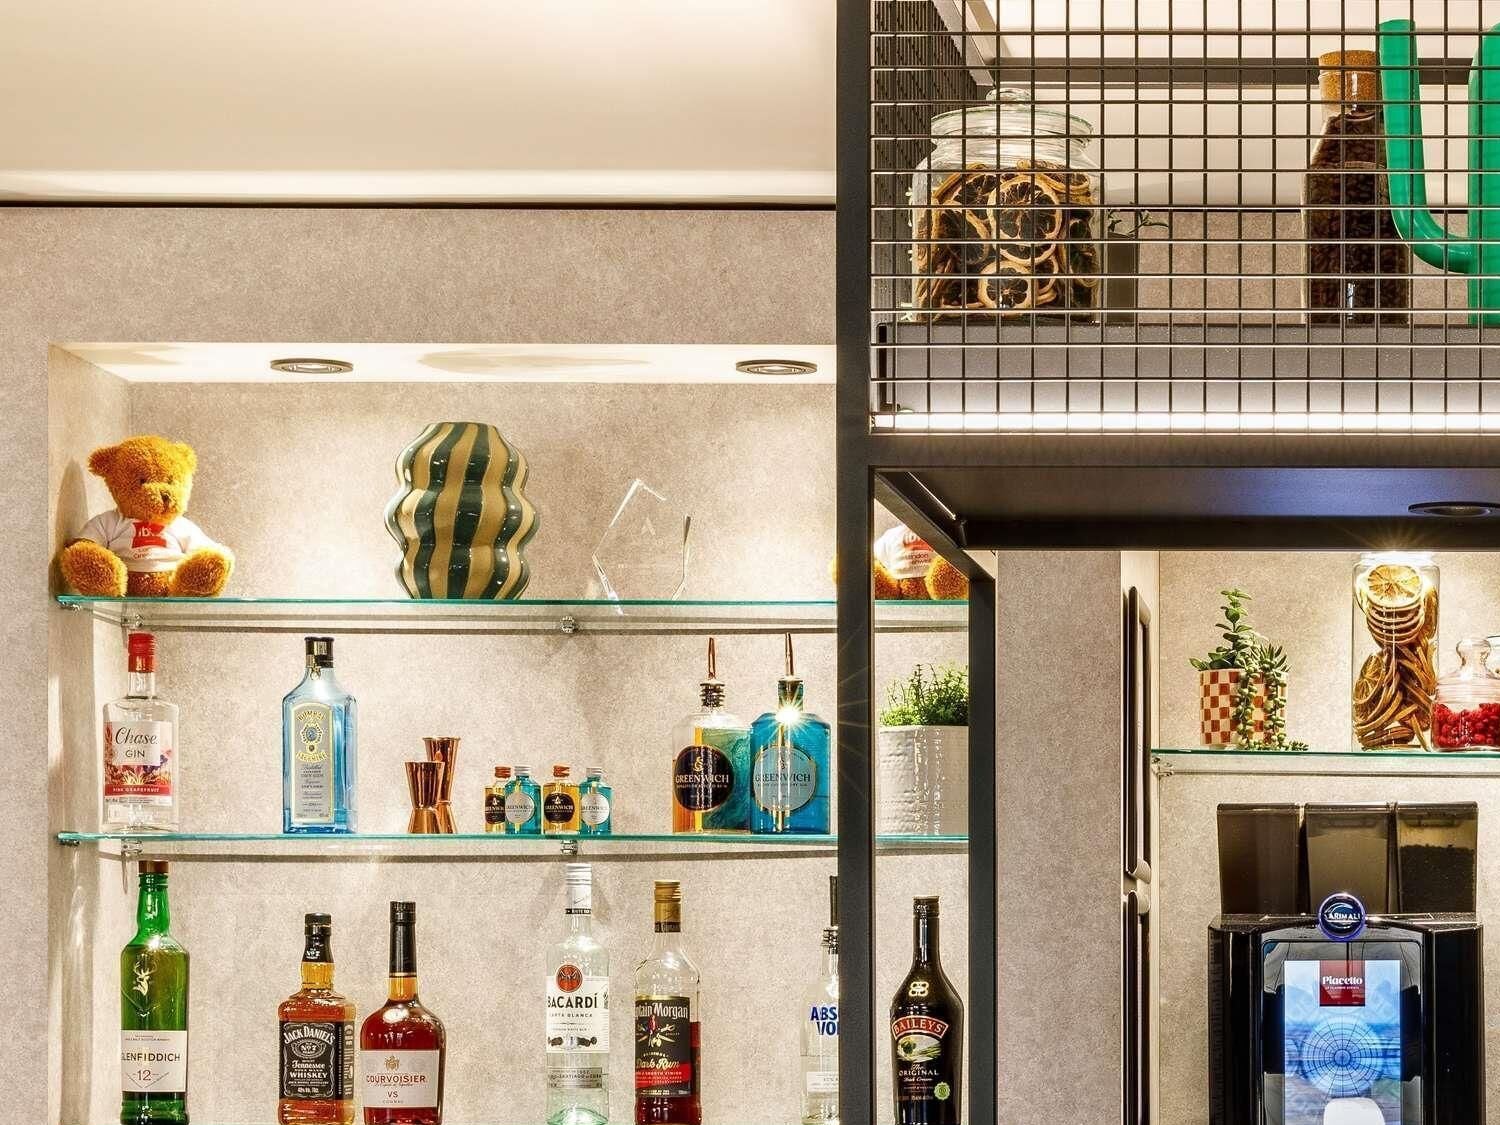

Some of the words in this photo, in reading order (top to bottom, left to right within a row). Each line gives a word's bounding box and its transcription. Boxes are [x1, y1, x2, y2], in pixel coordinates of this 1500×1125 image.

[125, 749, 146, 758] GIN
[675, 774, 729, 783] GREENWICH
[1322, 976, 1363, 985] Piacetto
[652, 1003, 689, 1020] Morgan
[810, 1006, 839, 1021] ABS
[816, 1022, 840, 1036] VO
[893, 1018, 944, 1035] BAILEYS
[283, 1028, 304, 1044] JACK
[292, 1060, 325, 1069] Tennessee
[656, 1058, 681, 1070] Rum
[137, 1069, 152, 1081] 12
[366, 1075, 427, 1083] COURVOISIER
